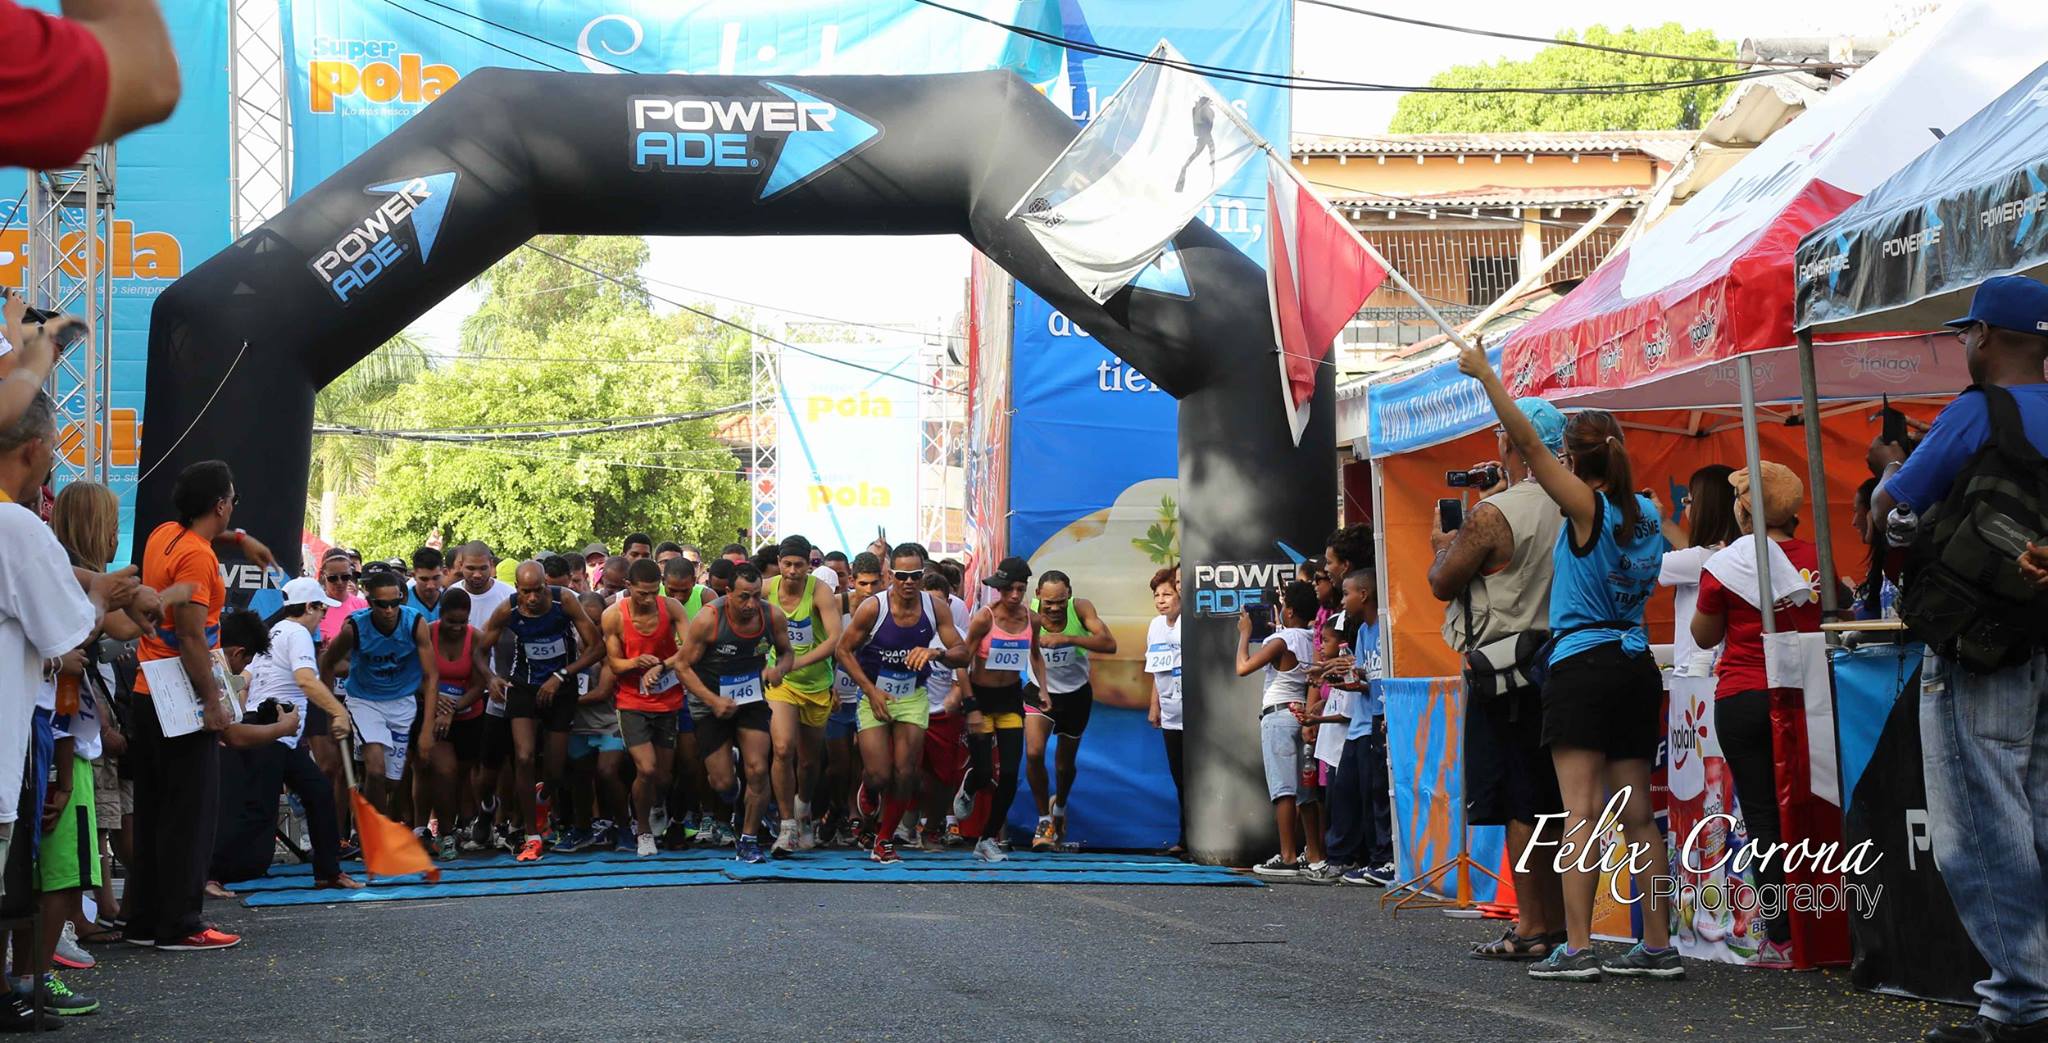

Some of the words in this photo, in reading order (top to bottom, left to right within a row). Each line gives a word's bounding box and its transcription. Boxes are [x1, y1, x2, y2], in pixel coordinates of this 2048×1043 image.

[634, 100, 836, 132] POWER
[313, 178, 432, 283] POWER
[531, 646, 556, 656] 251
[1045, 651, 1068, 662] 157
[995, 653, 1020, 665] 003
[1152, 655, 1172, 667] 240
[729, 684, 754, 700] 146
[884, 683, 909, 695] 315
